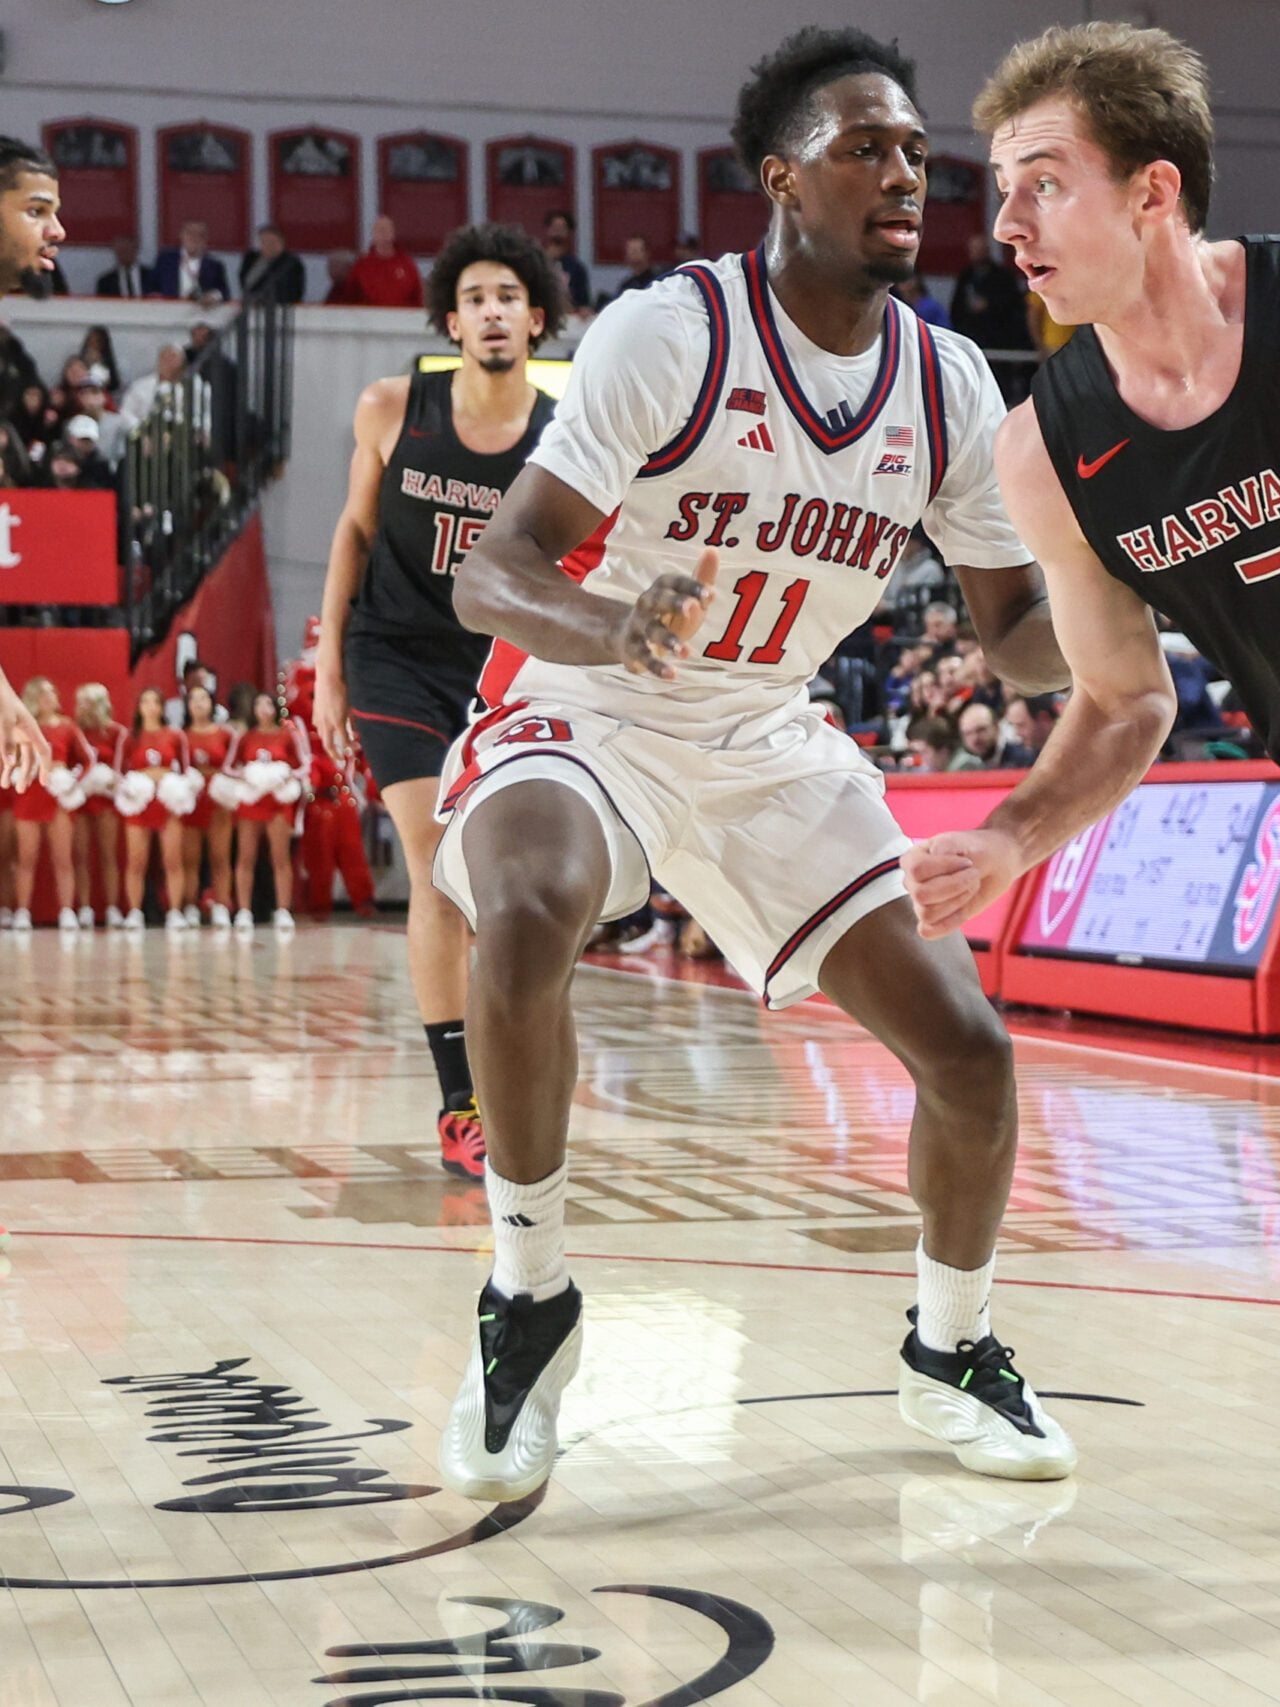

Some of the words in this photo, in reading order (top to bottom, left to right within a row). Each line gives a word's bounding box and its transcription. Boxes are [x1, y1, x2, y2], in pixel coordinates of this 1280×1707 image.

[402, 468, 502, 513] HARVA
[881, 454, 907, 464] BIG
[664, 492, 750, 547] ST.
[756, 494, 910, 580] JOHN'S
[702, 570, 811, 665] 11
